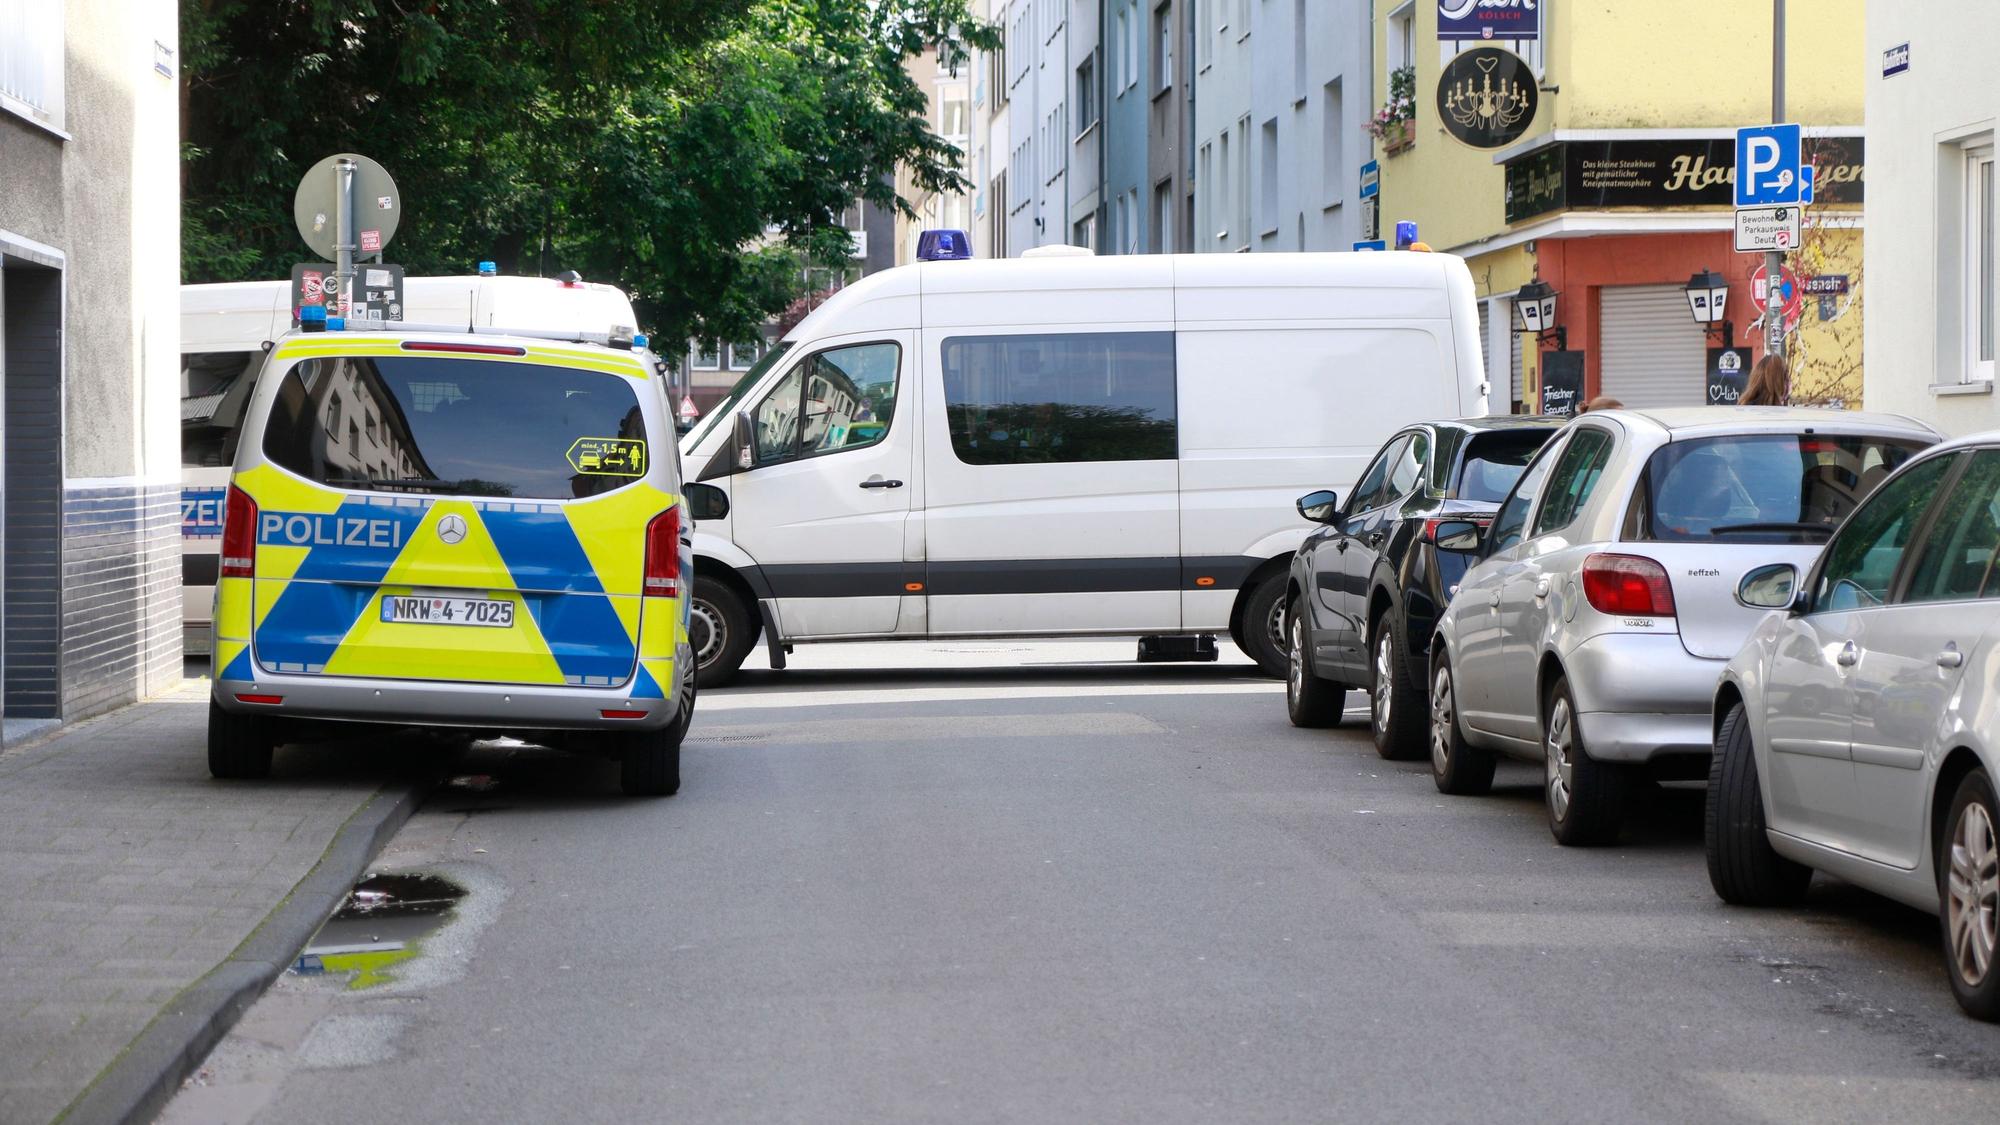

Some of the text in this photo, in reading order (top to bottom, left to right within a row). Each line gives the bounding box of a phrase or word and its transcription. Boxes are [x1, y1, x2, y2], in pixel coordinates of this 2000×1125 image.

[1478, 11, 1521, 20] KÖLSCH
[1583, 160, 1656, 169] Das kleine Steakhaus
[1746, 136, 1781, 196] P
[1582, 170, 1638, 179] mit gemütlicher
[1582, 179, 1652, 188] Kneipenatmosphäre
[1744, 225, 1790, 233] Parkausweis
[1544, 385, 1575, 402] Frischer
[601, 443, 618, 454] 1,5
[182, 499, 224, 527] ZEI
[261, 514, 400, 548] POLIZEI
[1688, 569, 1720, 577] #effzeh
[393, 598, 512, 624] NRW 4-7025
[1624, 618, 1655, 627] TOYOTA
